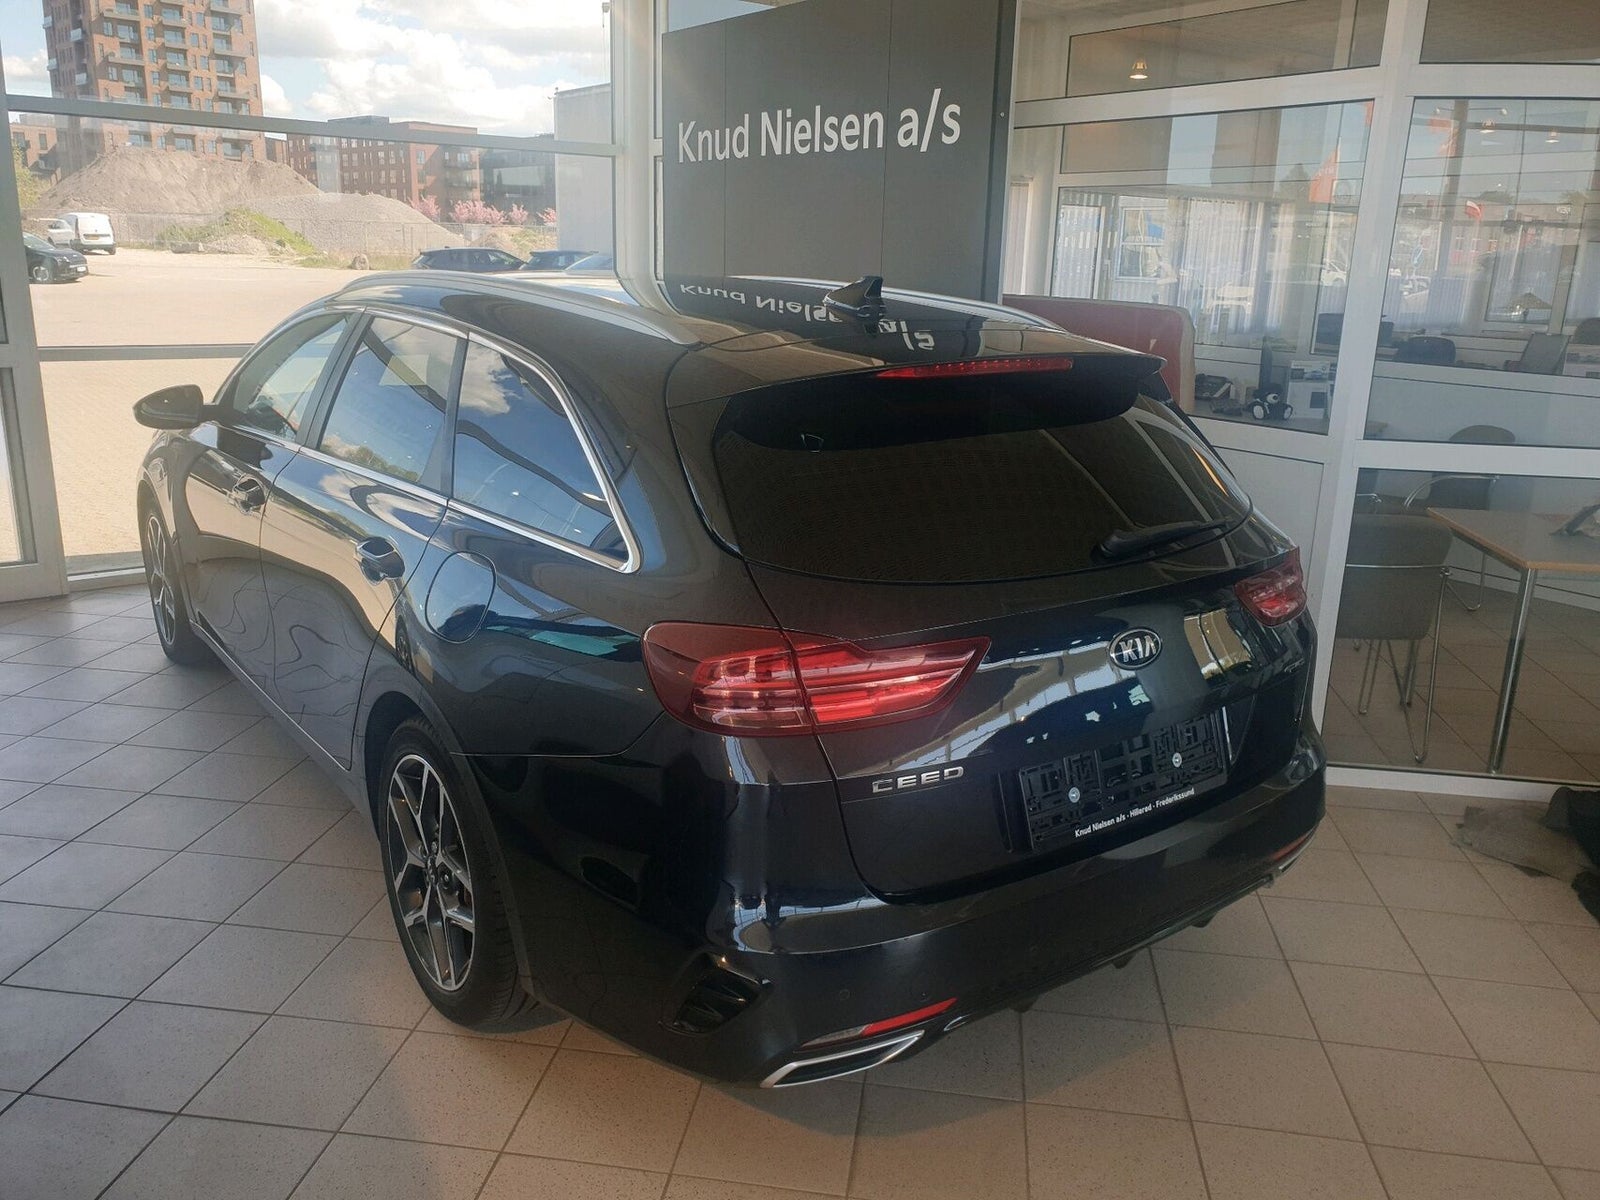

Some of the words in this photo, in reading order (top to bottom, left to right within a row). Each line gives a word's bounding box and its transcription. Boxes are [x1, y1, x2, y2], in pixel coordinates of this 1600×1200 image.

[678, 113, 750, 163] Knud
[760, 105, 884, 156] Nielsen
[896, 87, 961, 152] a/s
[1118, 635, 1157, 663] KIA
[872, 766, 964, 794] CEED
[1074, 825, 1092, 838] Knud
[1092, 816, 1116, 832] Nielsen
